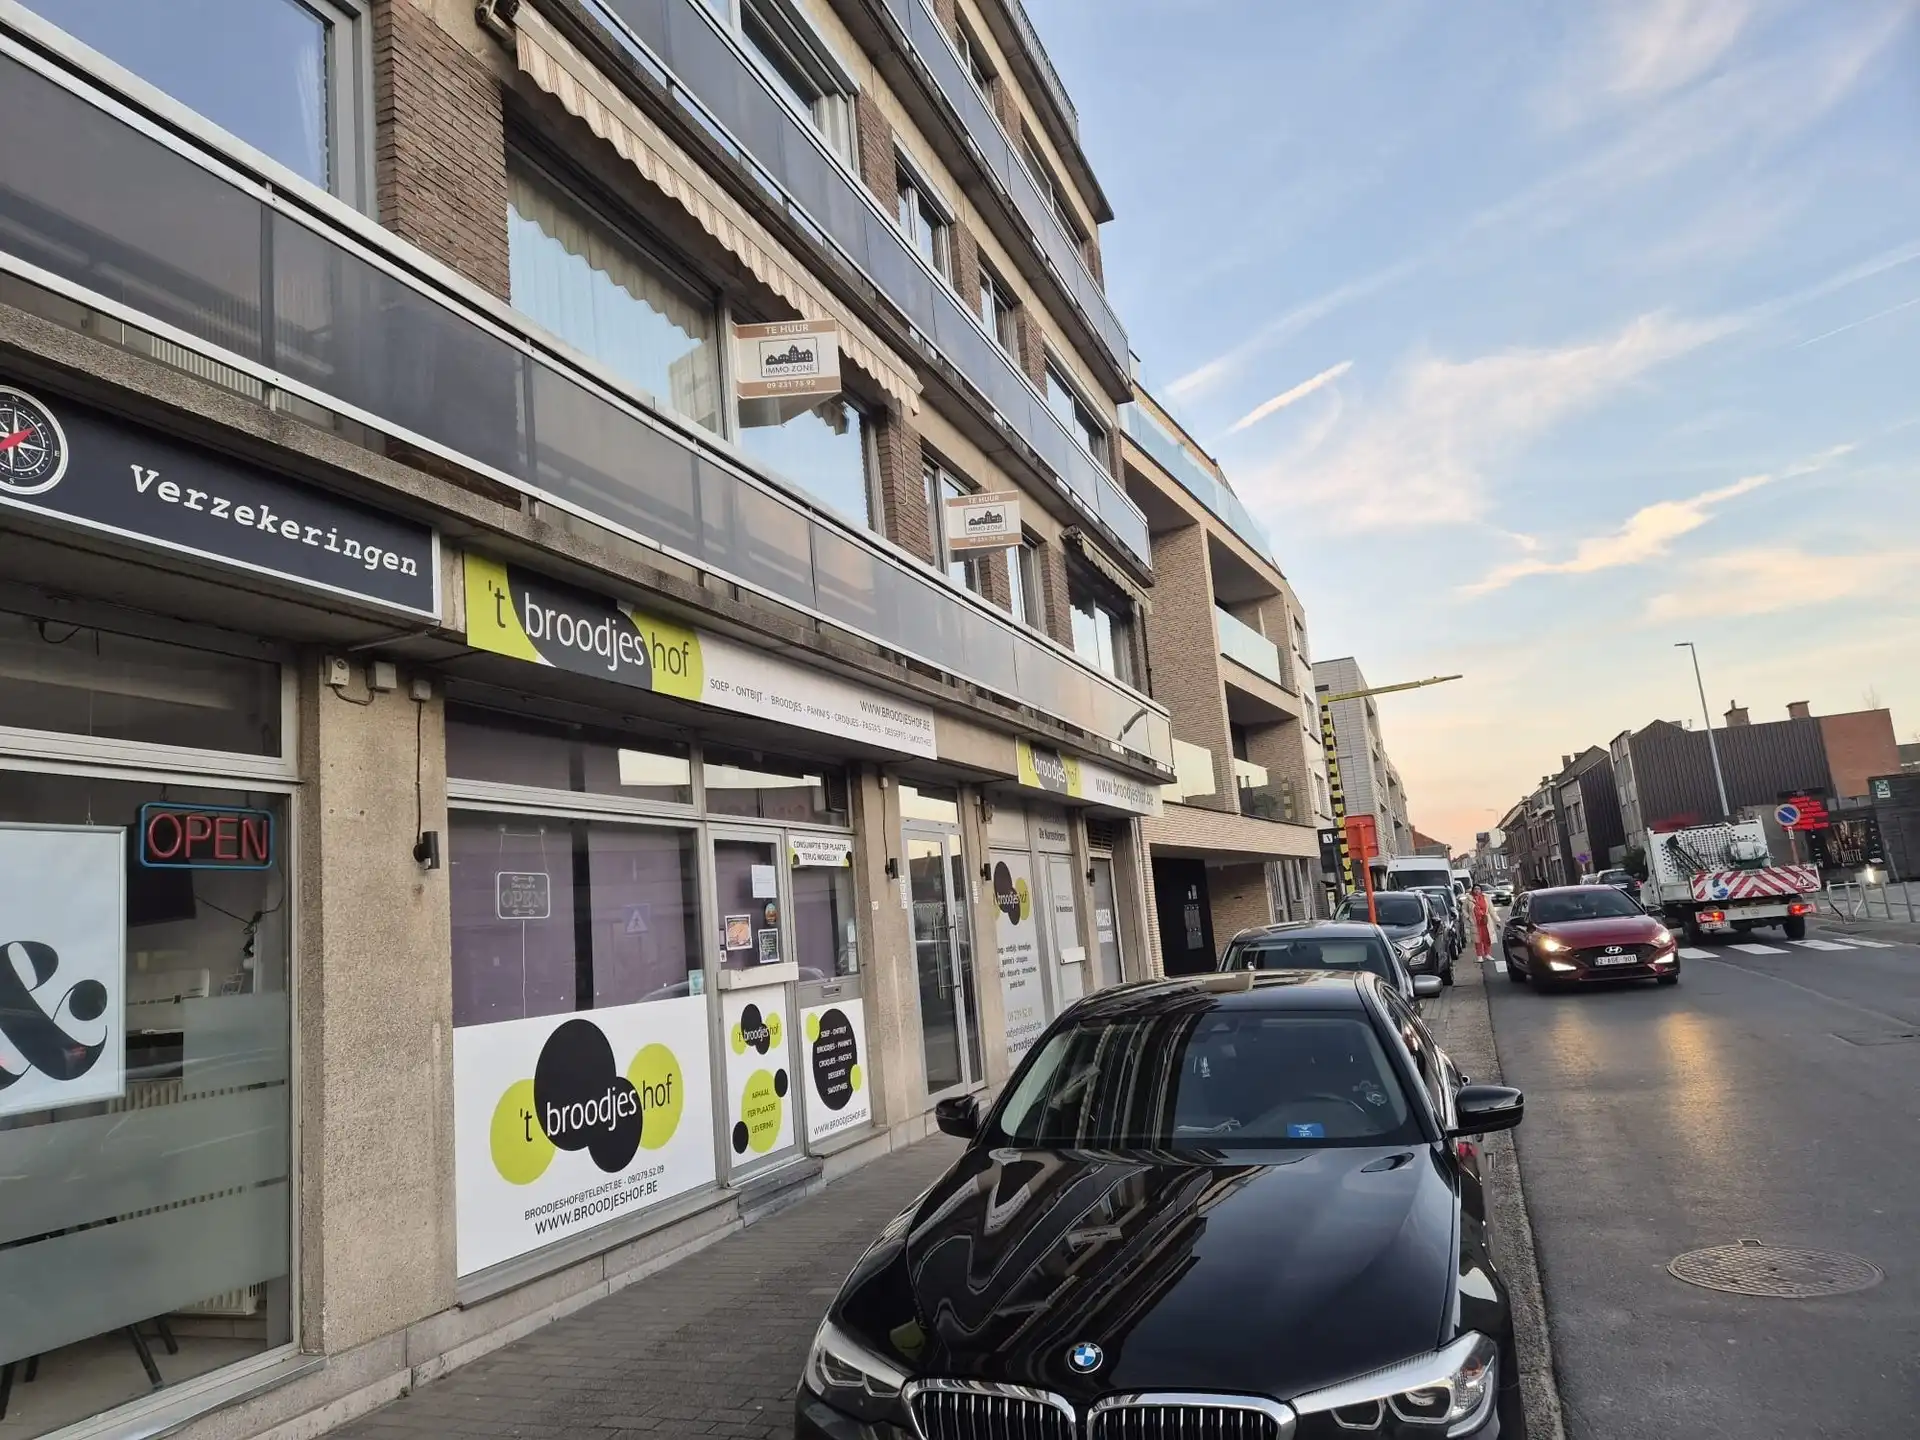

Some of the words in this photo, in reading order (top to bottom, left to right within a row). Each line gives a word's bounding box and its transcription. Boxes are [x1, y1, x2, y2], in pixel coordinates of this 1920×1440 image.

[765, 326, 776, 334] TE
[780, 324, 809, 332] HUUR
[766, 366, 788, 374] IMMO
[792, 363, 815, 371] ZONE
[130, 464, 418, 577] Verzekeringen
[488, 579, 506, 629] 't
[525, 592, 645, 672] broodjes
[651, 632, 690, 678] hof
[710, 678, 730, 692] SOEP
[735, 685, 763, 704] ONTBIJT
[770, 695, 803, 713] BROODJES
[859, 700, 931, 731] WWW.BROODJESHOF.BE
[1034, 752, 1066, 788] broodjes
[148, 812, 269, 861] OPEN
[501, 889, 547, 908] OPEN
[743, 1026, 769, 1042] broodjes
[769, 1022, 779, 1036] hof
[820, 1030, 830, 1039] SOEP
[816, 1043, 836, 1054] BROODJES
[519, 1108, 533, 1142] 't
[546, 1086, 637, 1137] broodjes
[642, 1073, 672, 1111] hof
[757, 1102, 776, 1115] PLAATSE
[814, 1108, 867, 1135] WWW.BROODJESHOF.BE
[751, 1119, 774, 1134] LEVERING
[524, 1180, 622, 1221] BROODJESHOF@TELENET.BE
[627, 1164, 665, 1185] 09/279.52.09
[535, 1180, 658, 1235] WWW.BROODJESHOF.BE
